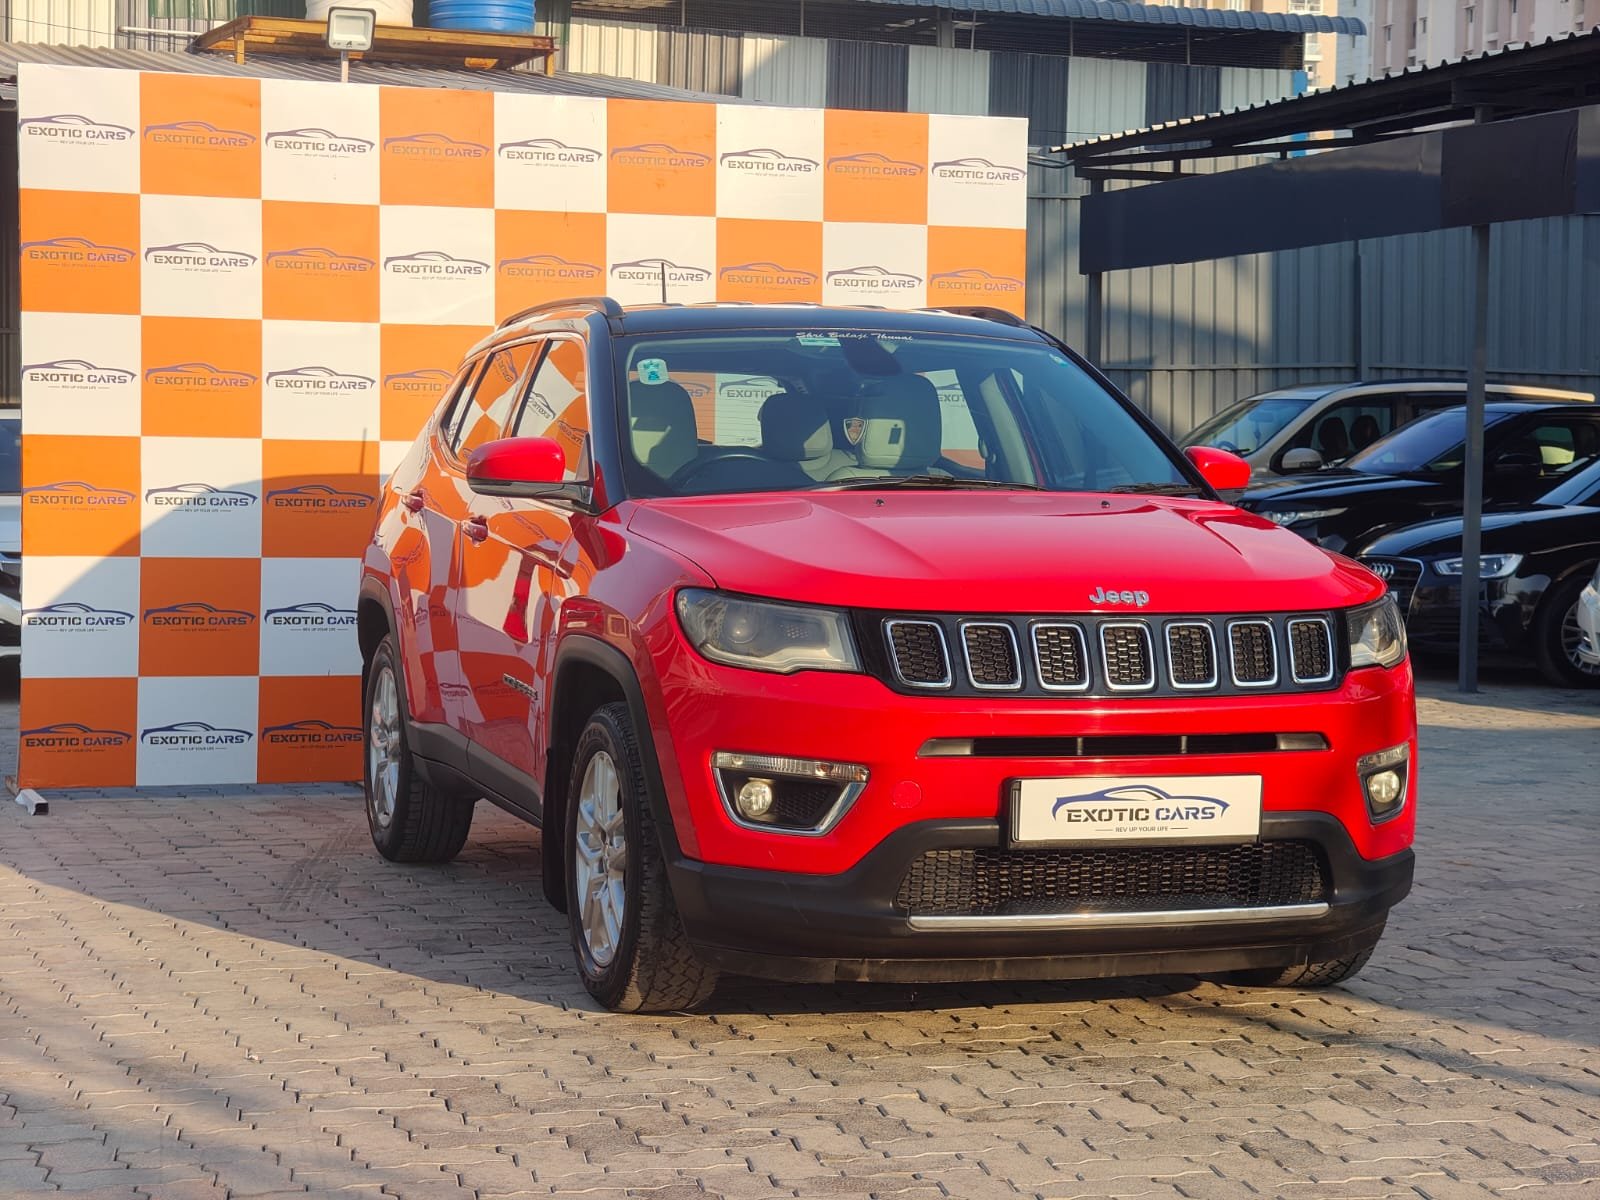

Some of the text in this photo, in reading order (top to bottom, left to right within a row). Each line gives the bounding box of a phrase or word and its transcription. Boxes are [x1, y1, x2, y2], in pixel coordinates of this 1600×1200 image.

[27, 126, 126, 141] EXOTIC CARS
[153, 133, 248, 147] EXOTIC CARS
[274, 140, 366, 153] EXOTIC CARS
[392, 145, 482, 158] EXOTIC CARS
[506, 150, 594, 163] EXOTIC CARS
[618, 155, 704, 168] EXOTIC CARS
[728, 160, 812, 173] EXOTIC CARS
[835, 165, 916, 177] EXOTIC CARS
[939, 169, 1019, 181] EXOTIC CARS
[29, 249, 127, 263] EXOTIC CARS
[154, 255, 249, 267] EXOTIC CARS
[275, 259, 368, 272] EXOTIC CARS
[392, 264, 482, 275] EXOTIC CARS
[507, 267, 594, 279] EXOTIC CARS
[619, 271, 704, 282] EXOTIC CARS
[727, 274, 811, 286] EXOTIC CARS
[834, 278, 915, 288] EXOTIC CARS
[938, 281, 1017, 292] EXOTIC CARS
[30, 372, 127, 384] EXOTIC CARS
[154, 375, 249, 388] EXOTIC CARS
[275, 379, 367, 390] EXOTIC CARS
[393, 383, 442, 392] EXOTIC
[29, 495, 127, 505] EXOTIC CARS
[154, 497, 249, 507] EXOTIC CARS
[274, 498, 366, 508] EXOTIC CARS
[1089, 586, 1149, 608] Jeep
[29, 616, 125, 626] EXOTIC CARS
[152, 616, 247, 626] EXOTIC CARS
[273, 616, 324, 625] EXOTIC
[25, 737, 123, 747] EXOTIC CARS
[150, 735, 244, 745] EXOTIC CARS
[270, 732, 362, 742] EXOTIC CARS
[1067, 805, 1215, 823] EXOTIC CARS
